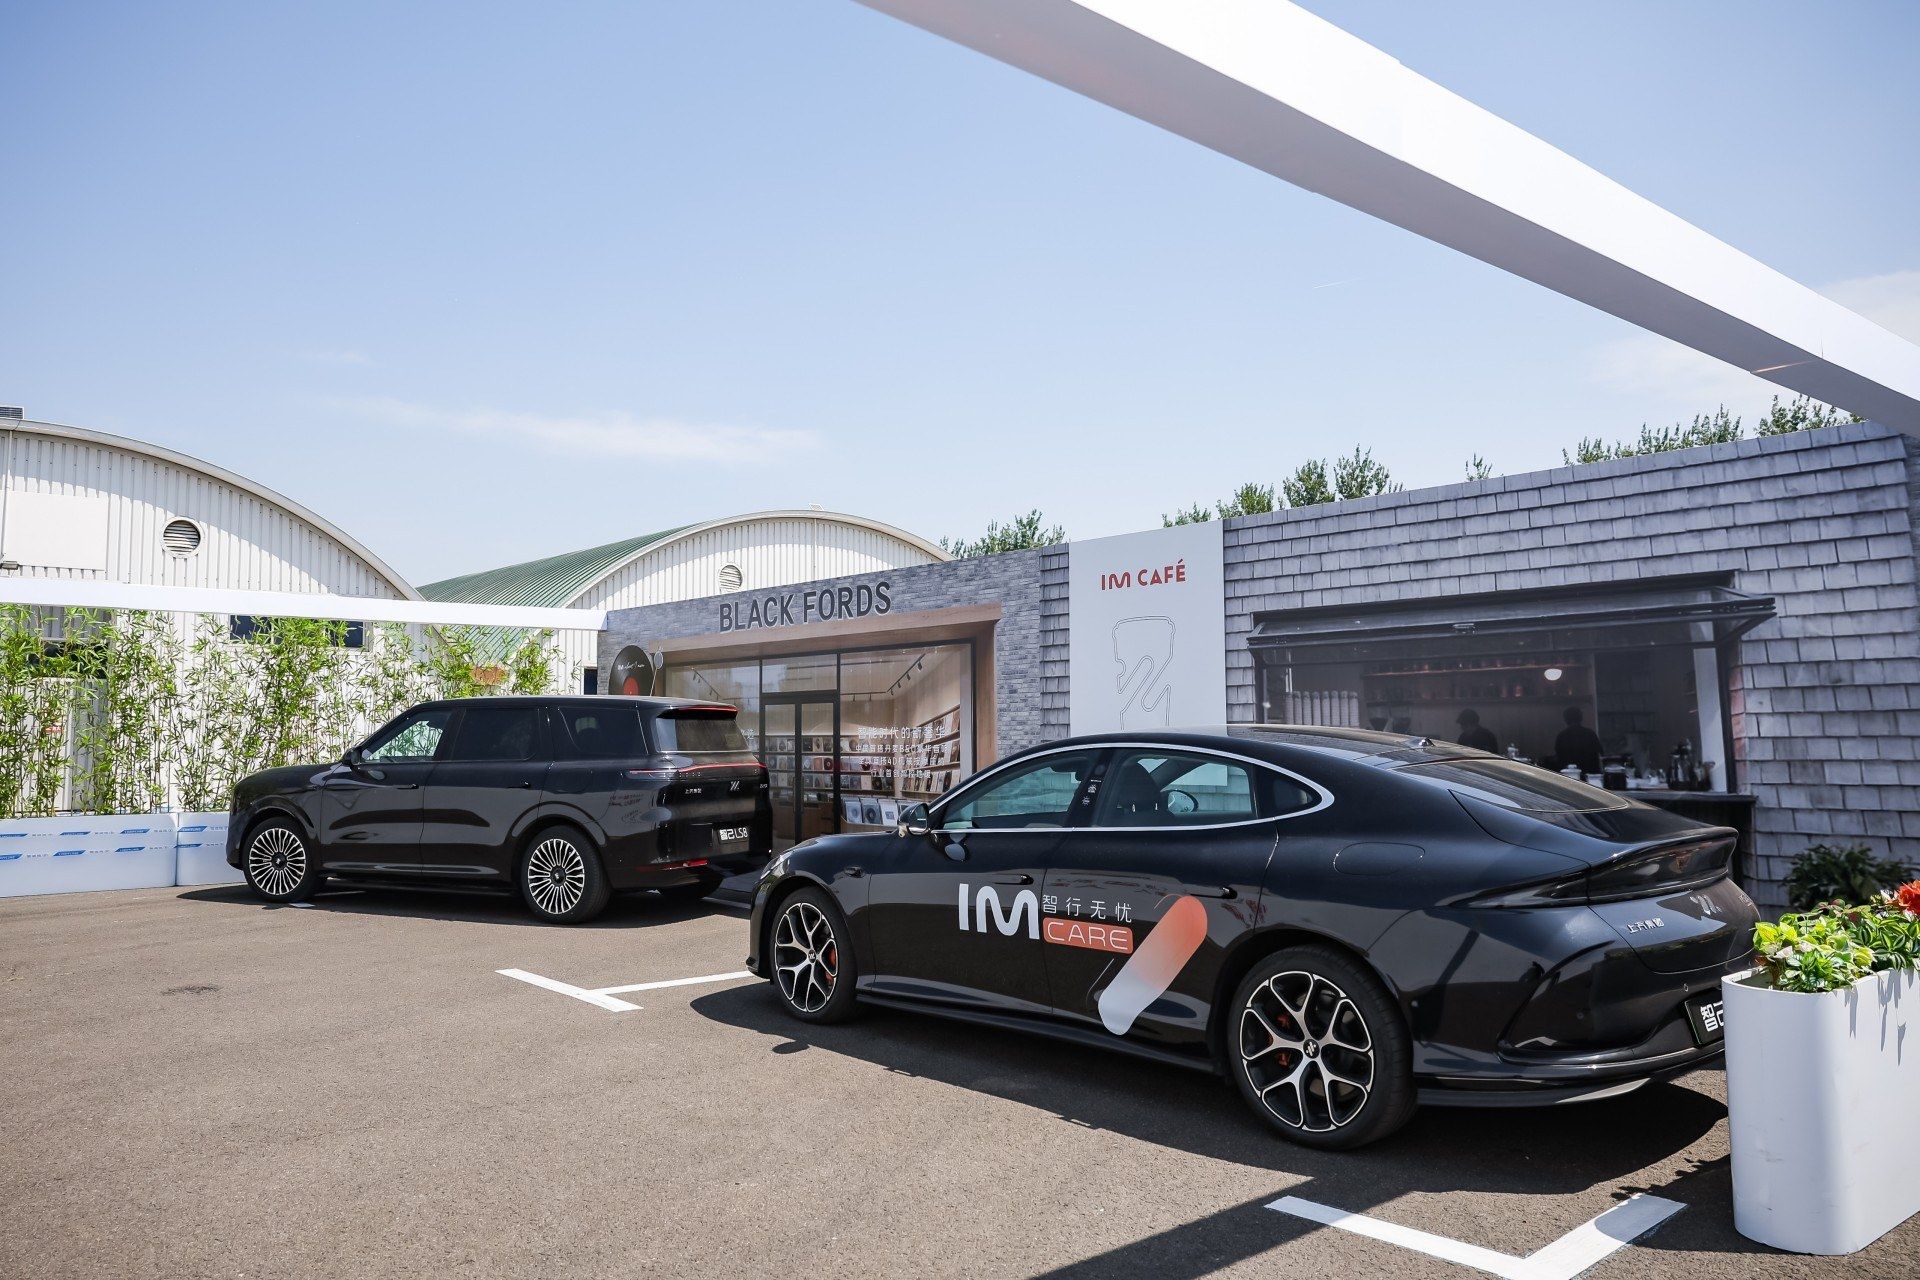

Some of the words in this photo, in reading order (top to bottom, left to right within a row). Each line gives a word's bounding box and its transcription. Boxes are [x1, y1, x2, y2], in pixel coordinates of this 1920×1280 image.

[1101, 571, 1131, 591] IM
[1137, 558, 1186, 587] CAFÉ
[719, 593, 795, 633] BLACK
[803, 581, 892, 623] FORDS
[958, 883, 1040, 940] IM
[1042, 894, 1132, 923] 智行无忧
[1047, 921, 1129, 951] CARE
